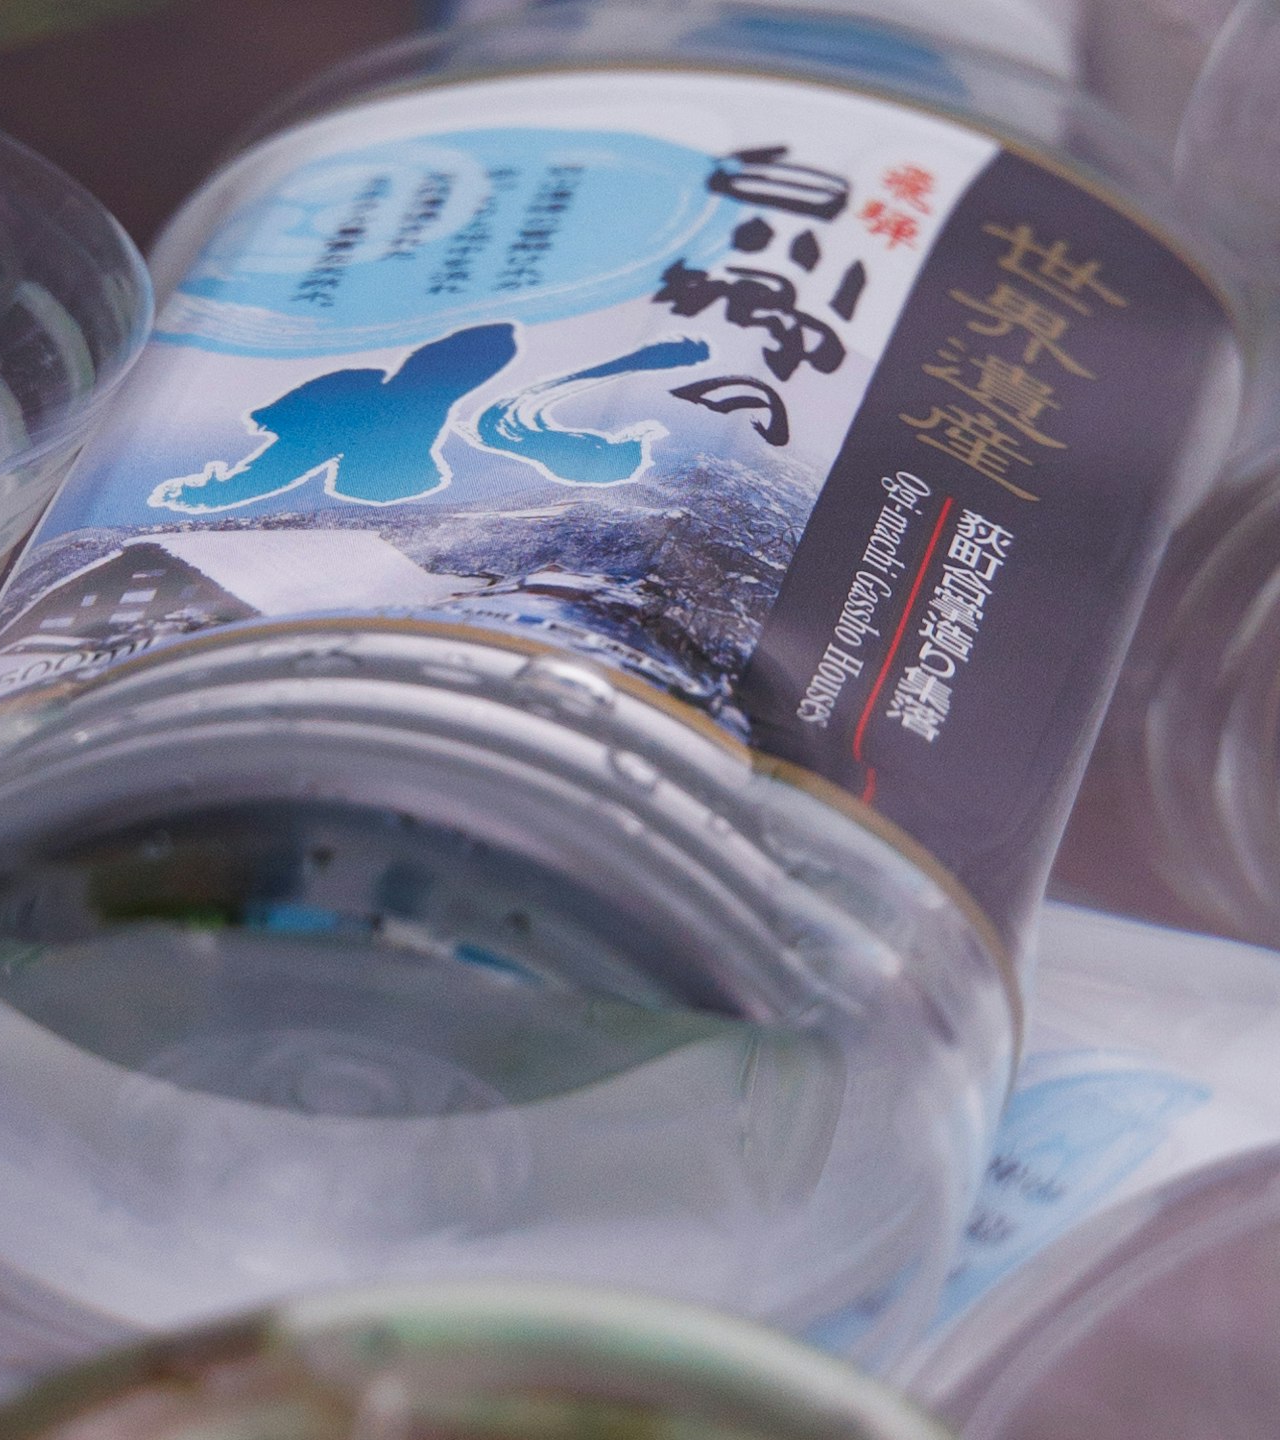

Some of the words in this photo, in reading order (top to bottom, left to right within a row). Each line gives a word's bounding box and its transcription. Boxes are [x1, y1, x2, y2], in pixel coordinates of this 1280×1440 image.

[898, 224, 1130, 502] 世界遺産
[861, 470, 931, 580] Ogi-machi
[833, 568, 893, 647] Gassho
[885, 507, 1015, 743] 荻町合掌造り集落
[795, 642, 865, 729] Houses
